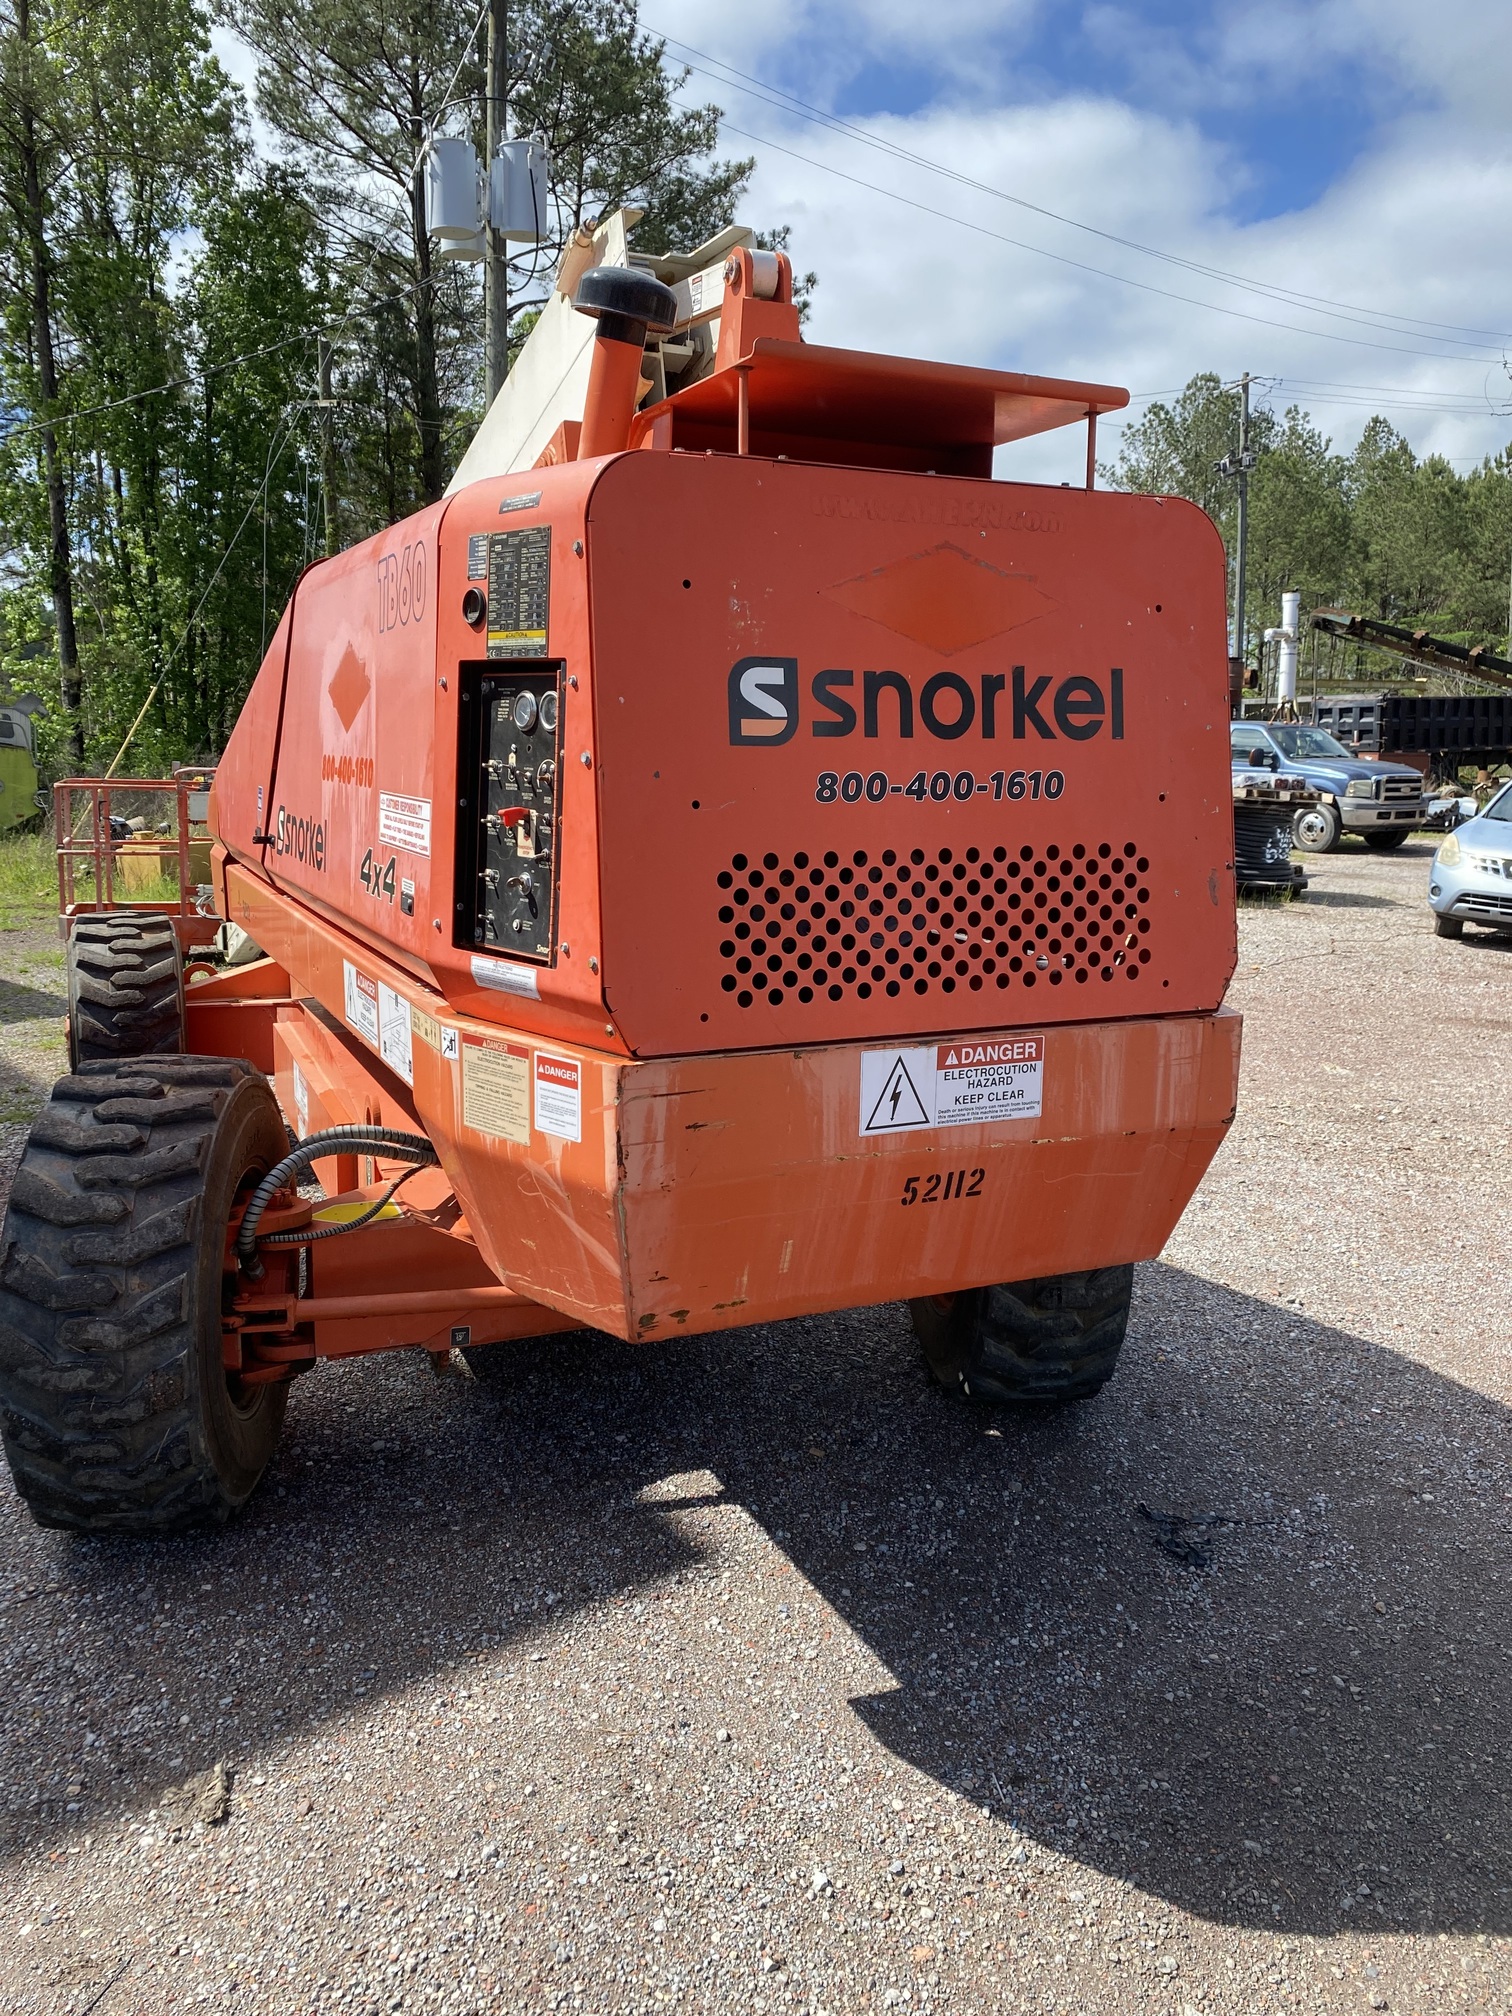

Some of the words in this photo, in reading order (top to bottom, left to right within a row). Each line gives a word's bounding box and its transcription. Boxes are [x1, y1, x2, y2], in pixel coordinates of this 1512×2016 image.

[378, 540, 426, 633] TB60
[812, 665, 1123, 740] snorkel
[322, 754, 373, 788] 800-400-1610
[815, 770, 1065, 804] 800-400-1610
[360, 847, 396, 905] 4x4
[486, 1040, 508, 1052] DANGER
[962, 1042, 1037, 1064] DANGER
[545, 1065, 577, 1082] DANGER
[944, 1064, 1037, 1081] ELECTROCUTION
[968, 1076, 1013, 1089] HAZARD
[954, 1094, 984, 1105] KEEP
[988, 1090, 1024, 1102] CLEAR
[901, 1168, 986, 1206] 52112
